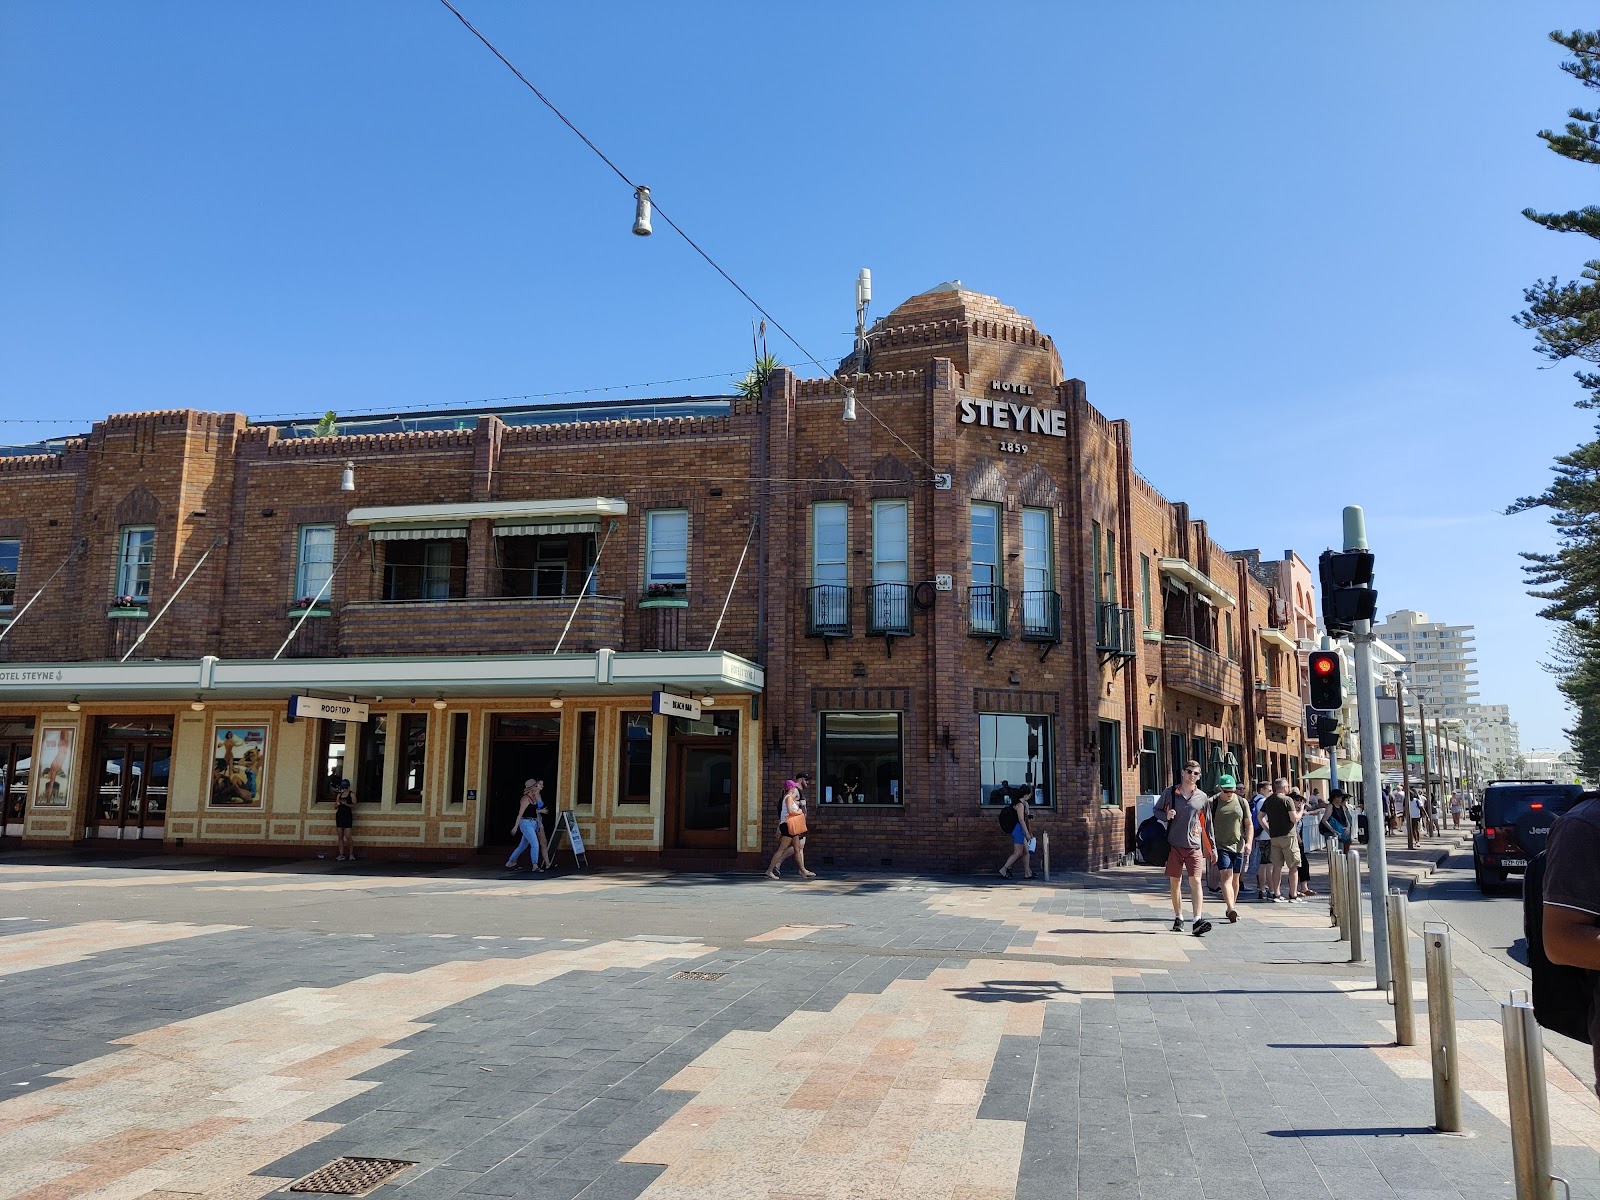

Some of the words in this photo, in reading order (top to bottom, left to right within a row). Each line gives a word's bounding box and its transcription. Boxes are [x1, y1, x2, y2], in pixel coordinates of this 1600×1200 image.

[992, 380, 1034, 395] HOTEL
[960, 398, 1067, 437] STEYNE
[1000, 442, 1028, 454] 1859
[22, 672, 54, 680] STEYNE
[321, 705, 350, 714] ROOFTOP
[672, 701, 684, 710] BEACH
